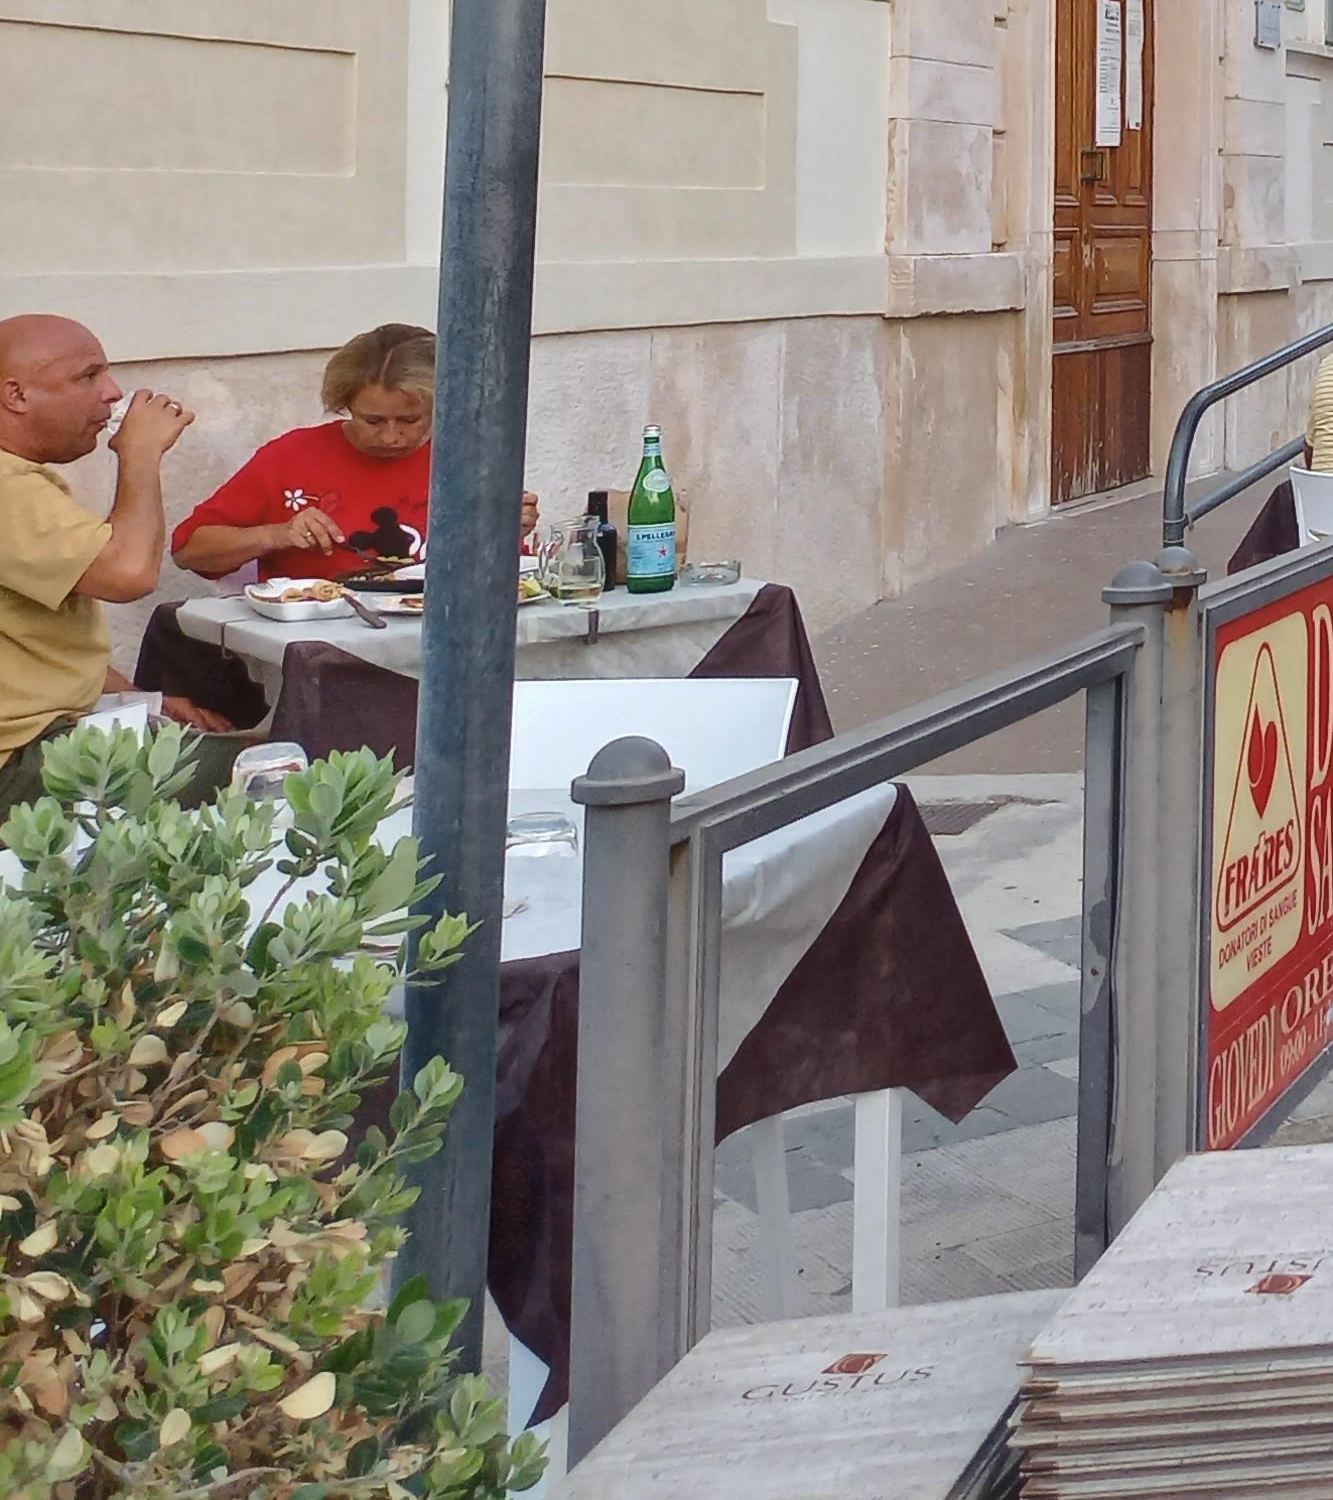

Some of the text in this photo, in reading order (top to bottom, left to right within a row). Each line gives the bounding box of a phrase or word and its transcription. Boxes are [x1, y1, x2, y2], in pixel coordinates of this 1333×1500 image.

[1223, 818, 1295, 918] FRATRES
[1218, 888, 1299, 971] DONATORI DI SANGUE
[1246, 935, 1273, 973] VIESTE
[740, 1364, 936, 1401] GUSTUS
